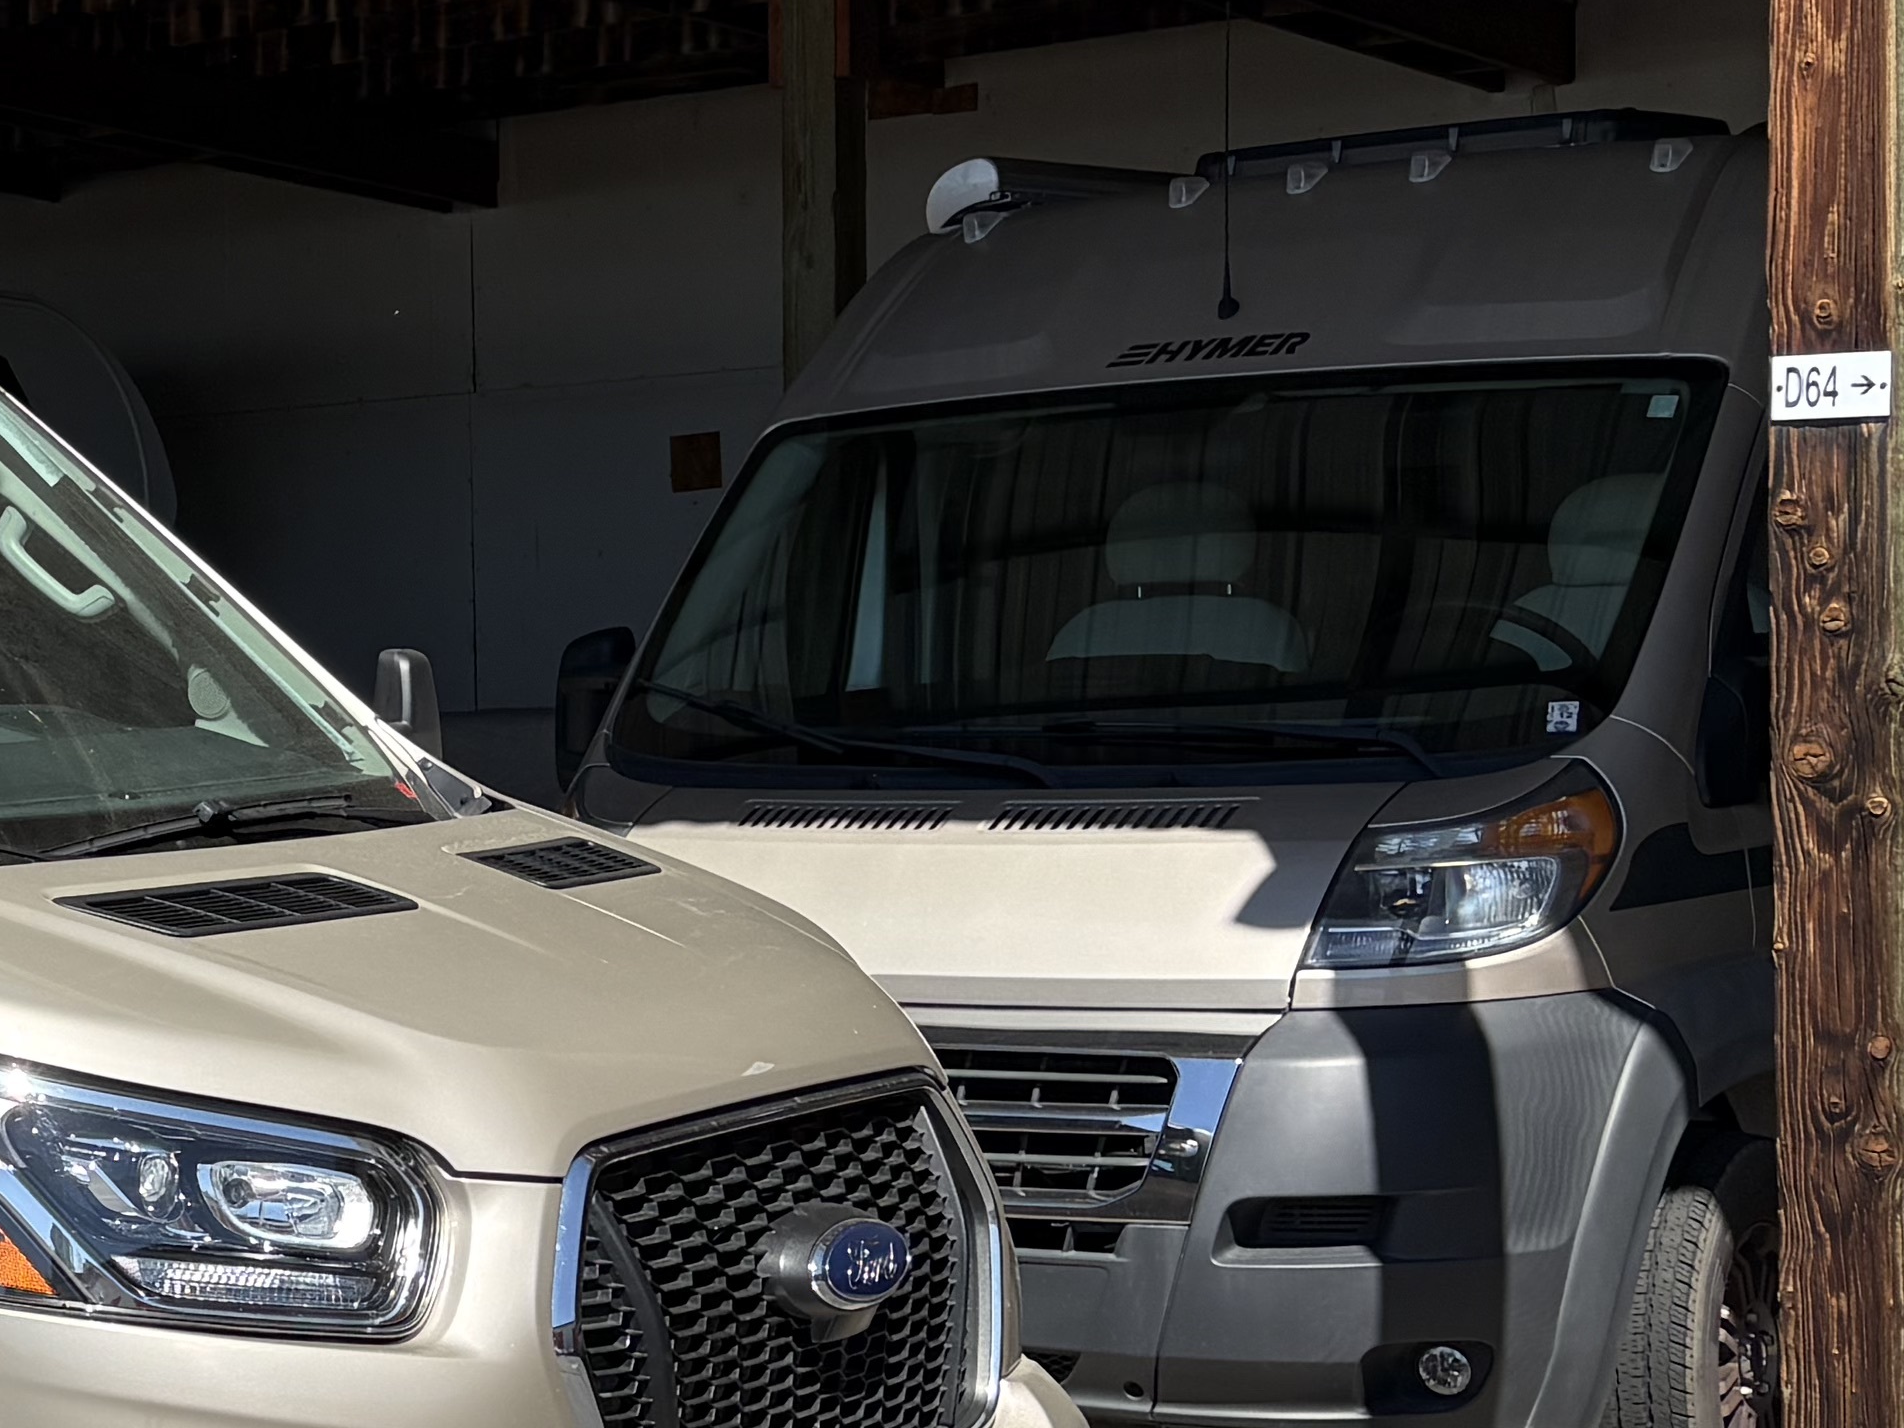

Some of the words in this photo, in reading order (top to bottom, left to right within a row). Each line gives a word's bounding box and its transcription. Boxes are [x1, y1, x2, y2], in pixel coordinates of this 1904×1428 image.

[1145, 331, 1311, 365] HYMER
[1785, 365, 1839, 408] D64
[847, 1241, 898, 1290] Ford
